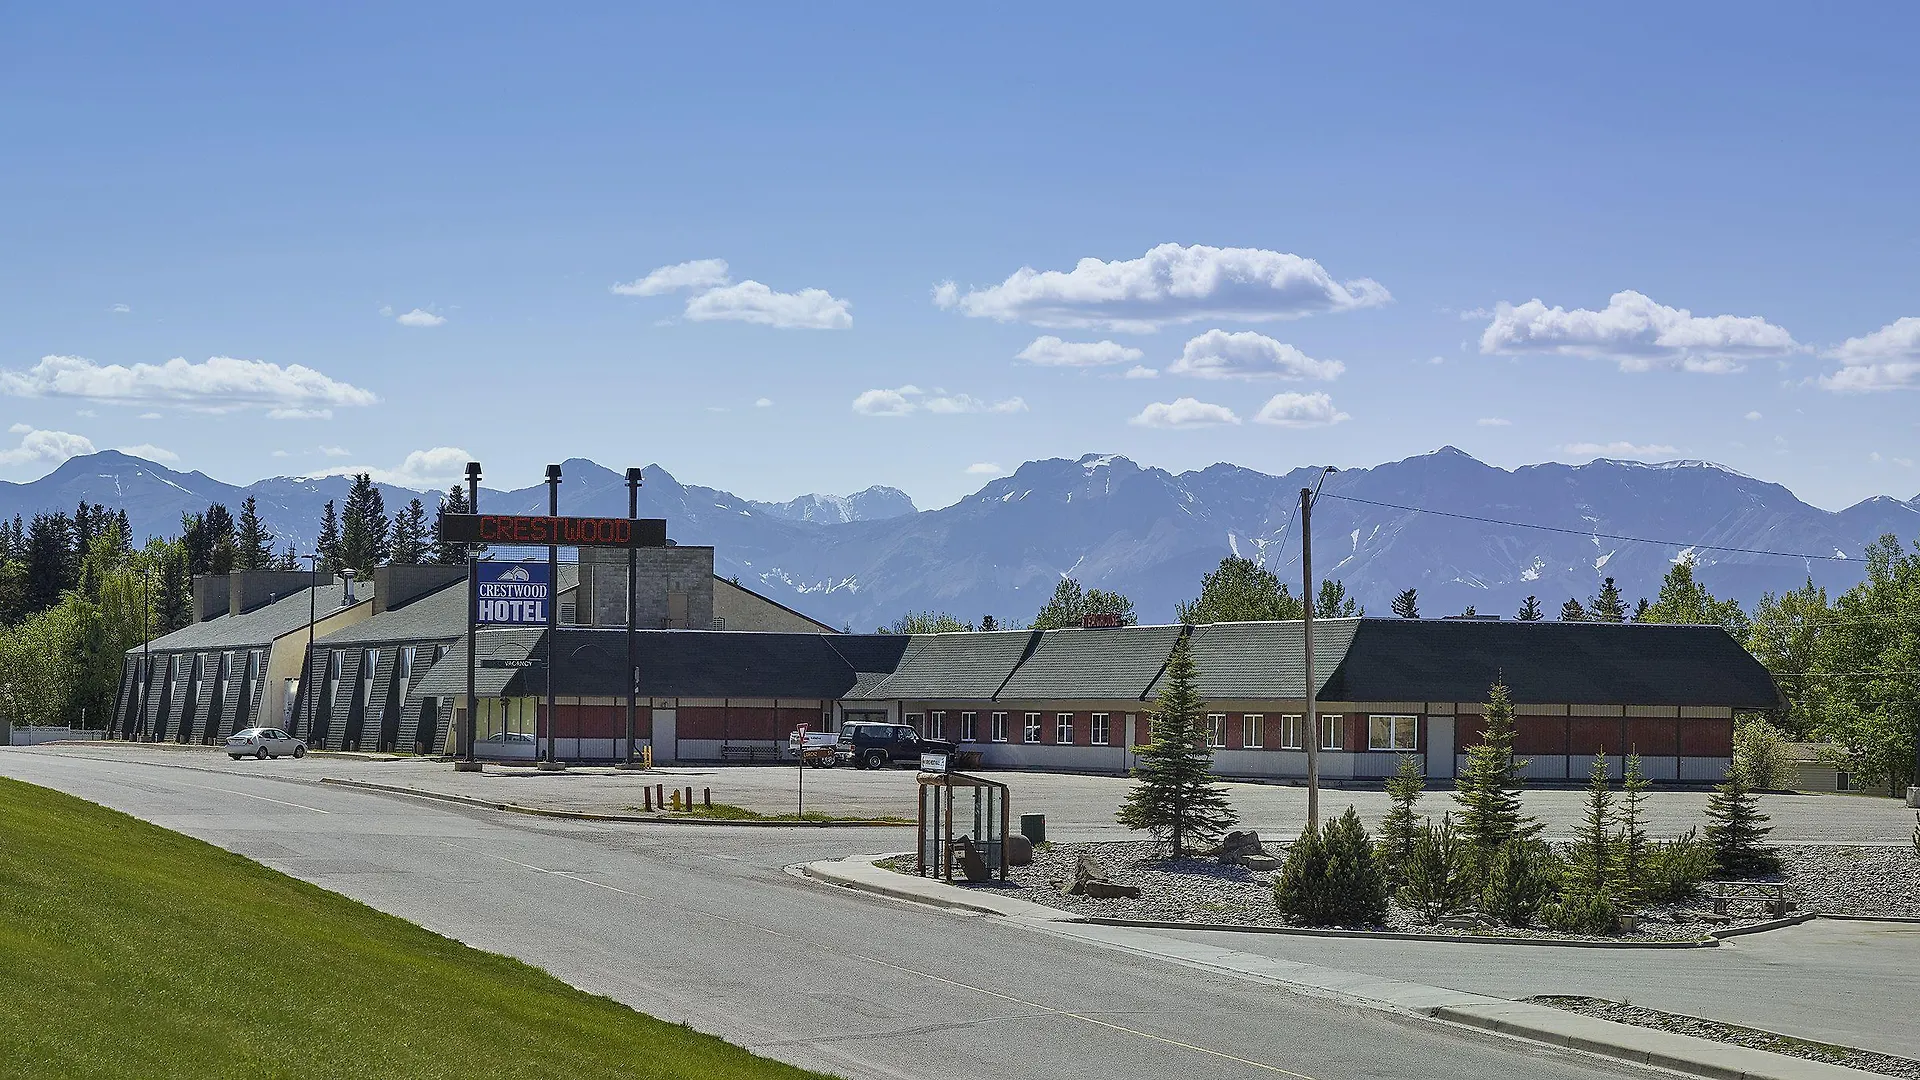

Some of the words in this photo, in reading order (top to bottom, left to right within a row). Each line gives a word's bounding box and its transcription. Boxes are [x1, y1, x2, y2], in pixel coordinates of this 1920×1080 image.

[479, 516, 631, 543] CRESTWOOD
[479, 584, 547, 598] CRESTWOOD
[479, 600, 547, 622] HOTEL
